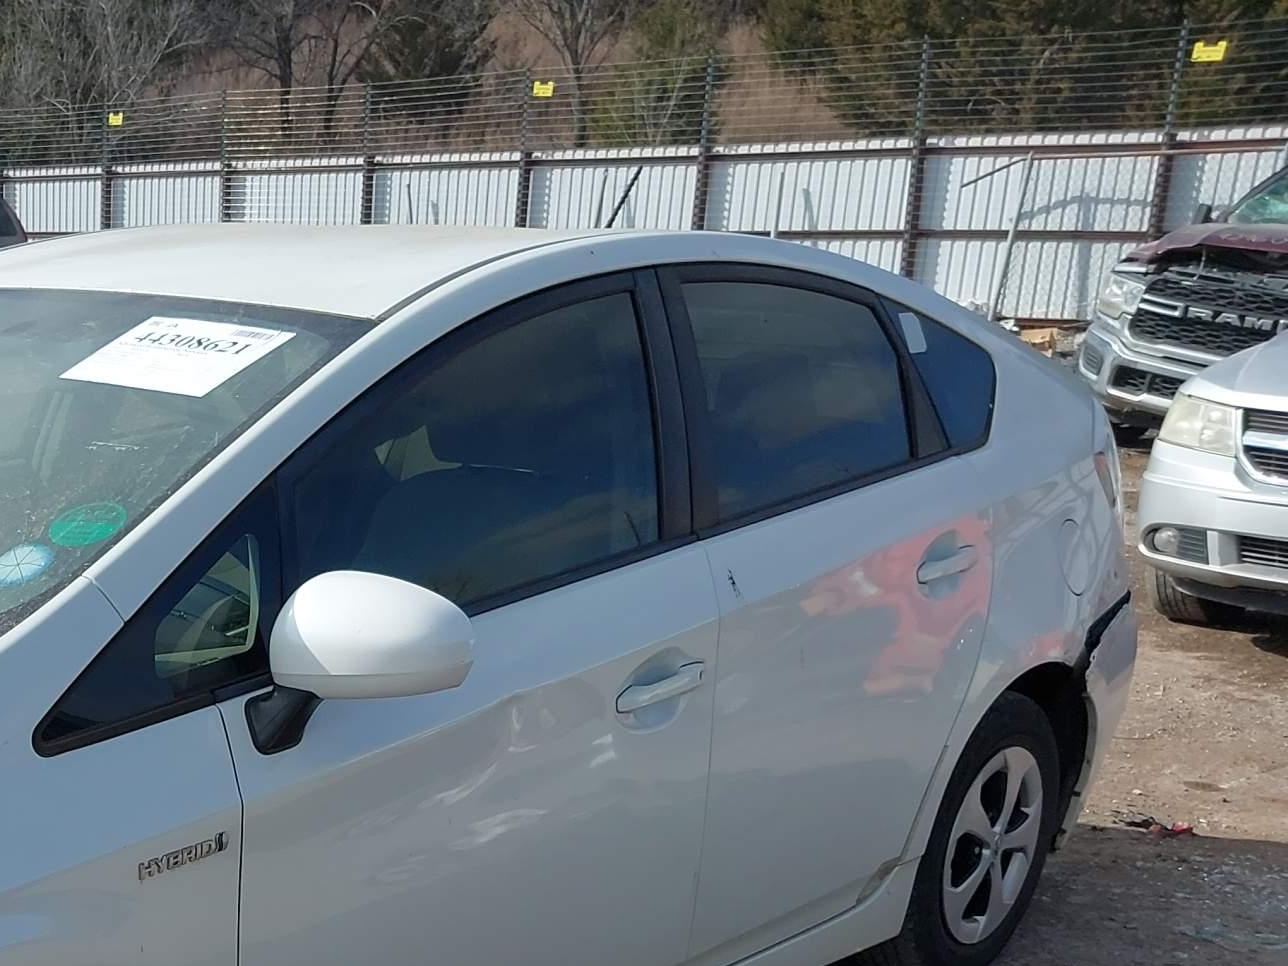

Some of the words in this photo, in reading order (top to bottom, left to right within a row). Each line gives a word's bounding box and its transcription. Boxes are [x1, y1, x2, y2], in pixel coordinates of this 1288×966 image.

[1187, 306, 1274, 331] RAM
[135, 331, 252, 355] 44308621
[138, 839, 215, 881] HYBRID
